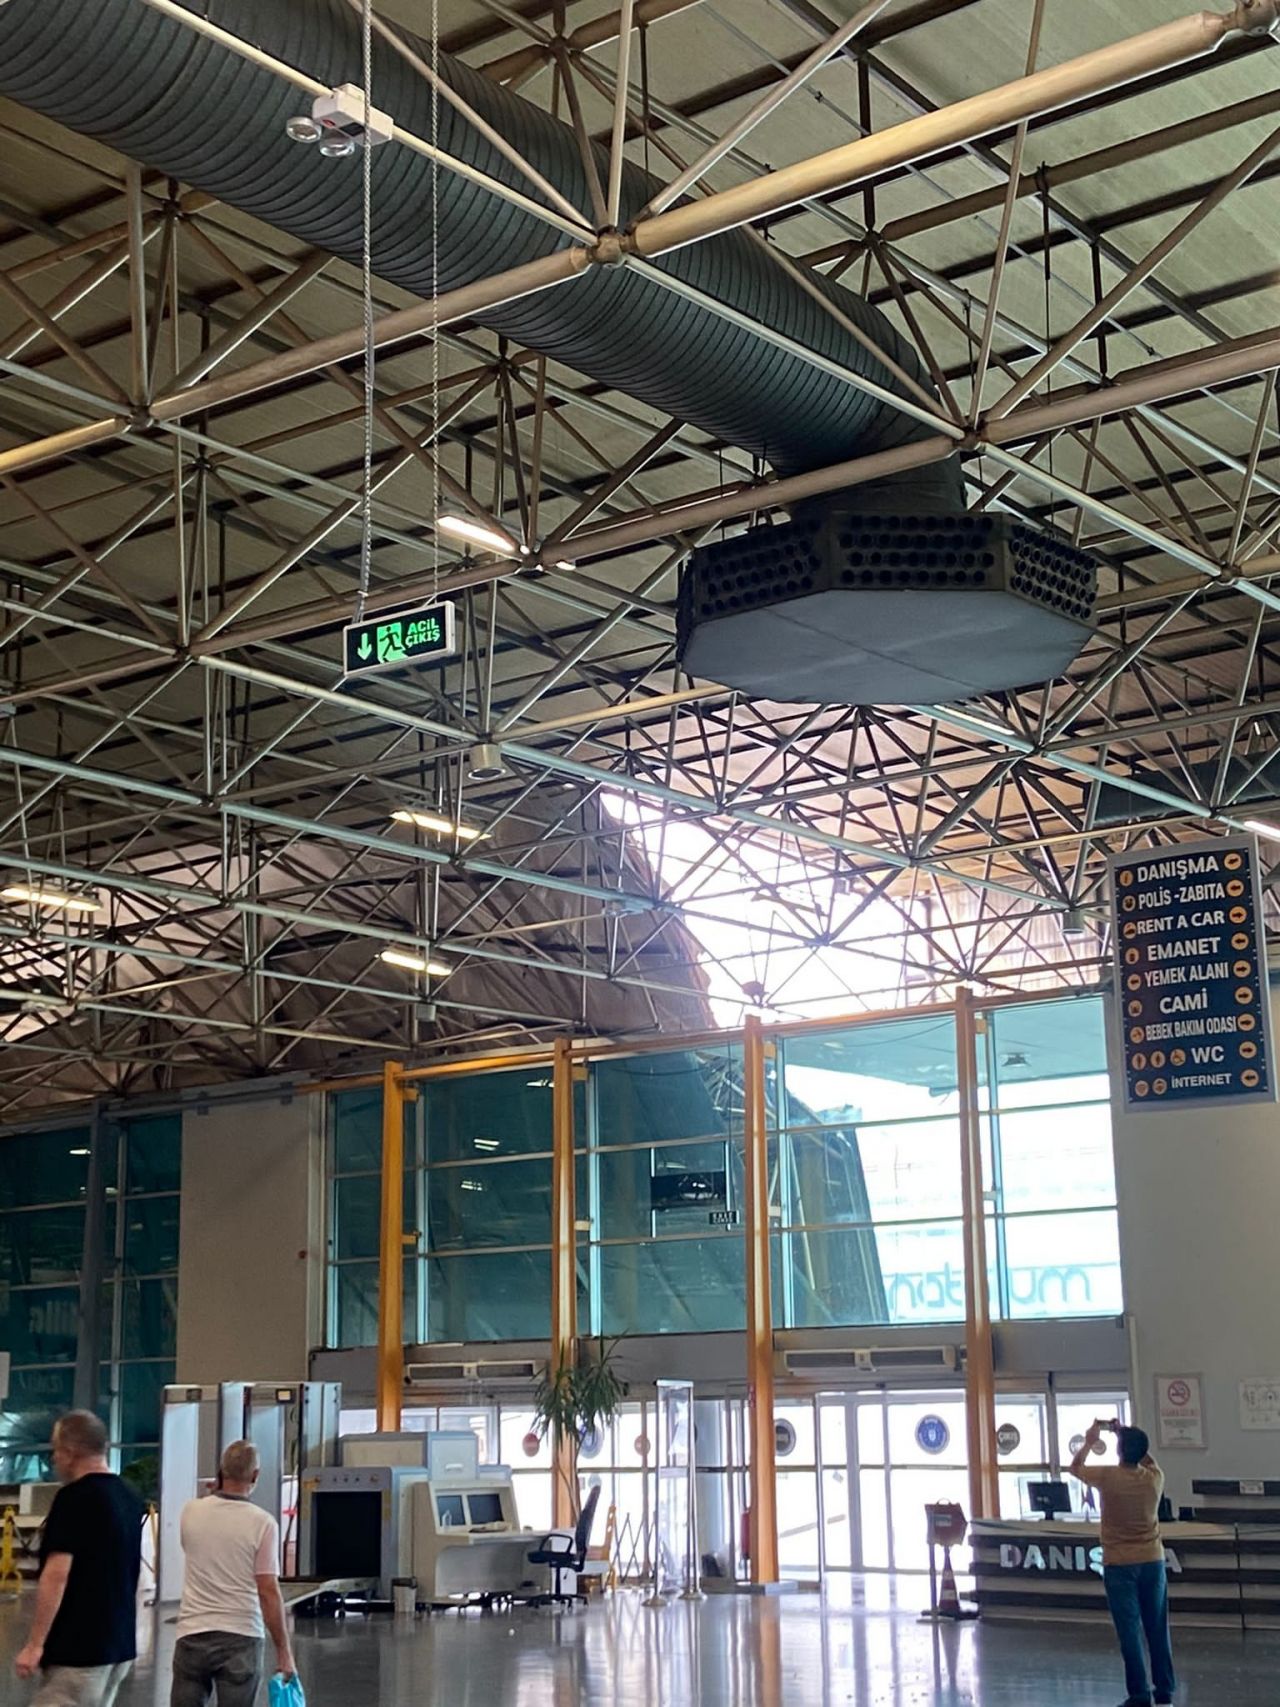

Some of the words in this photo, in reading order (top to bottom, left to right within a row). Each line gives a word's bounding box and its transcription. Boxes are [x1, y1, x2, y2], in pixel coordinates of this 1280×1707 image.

[405, 629, 440, 648] ÇIKIŞ
[1137, 856, 1219, 882] DANIŞMA
[1138, 886, 1171, 909] POLİS
[1137, 916, 1173, 934] RENT
[1177, 915, 1188, 928] A
[1191, 910, 1225, 927] CAR
[1147, 937, 1220, 961] EMANET
[1144, 967, 1187, 987] YEMEK
[1189, 962, 1229, 981] ALANI
[1160, 987, 1208, 1014] CAMİ
[1145, 1022, 1173, 1041] BEBEK
[1174, 1019, 1204, 1037] BAKIM
[1206, 1016, 1237, 1034] ODASI
[1191, 1046, 1224, 1064] WC
[1000, 1544, 1182, 1577] DANIŞA
